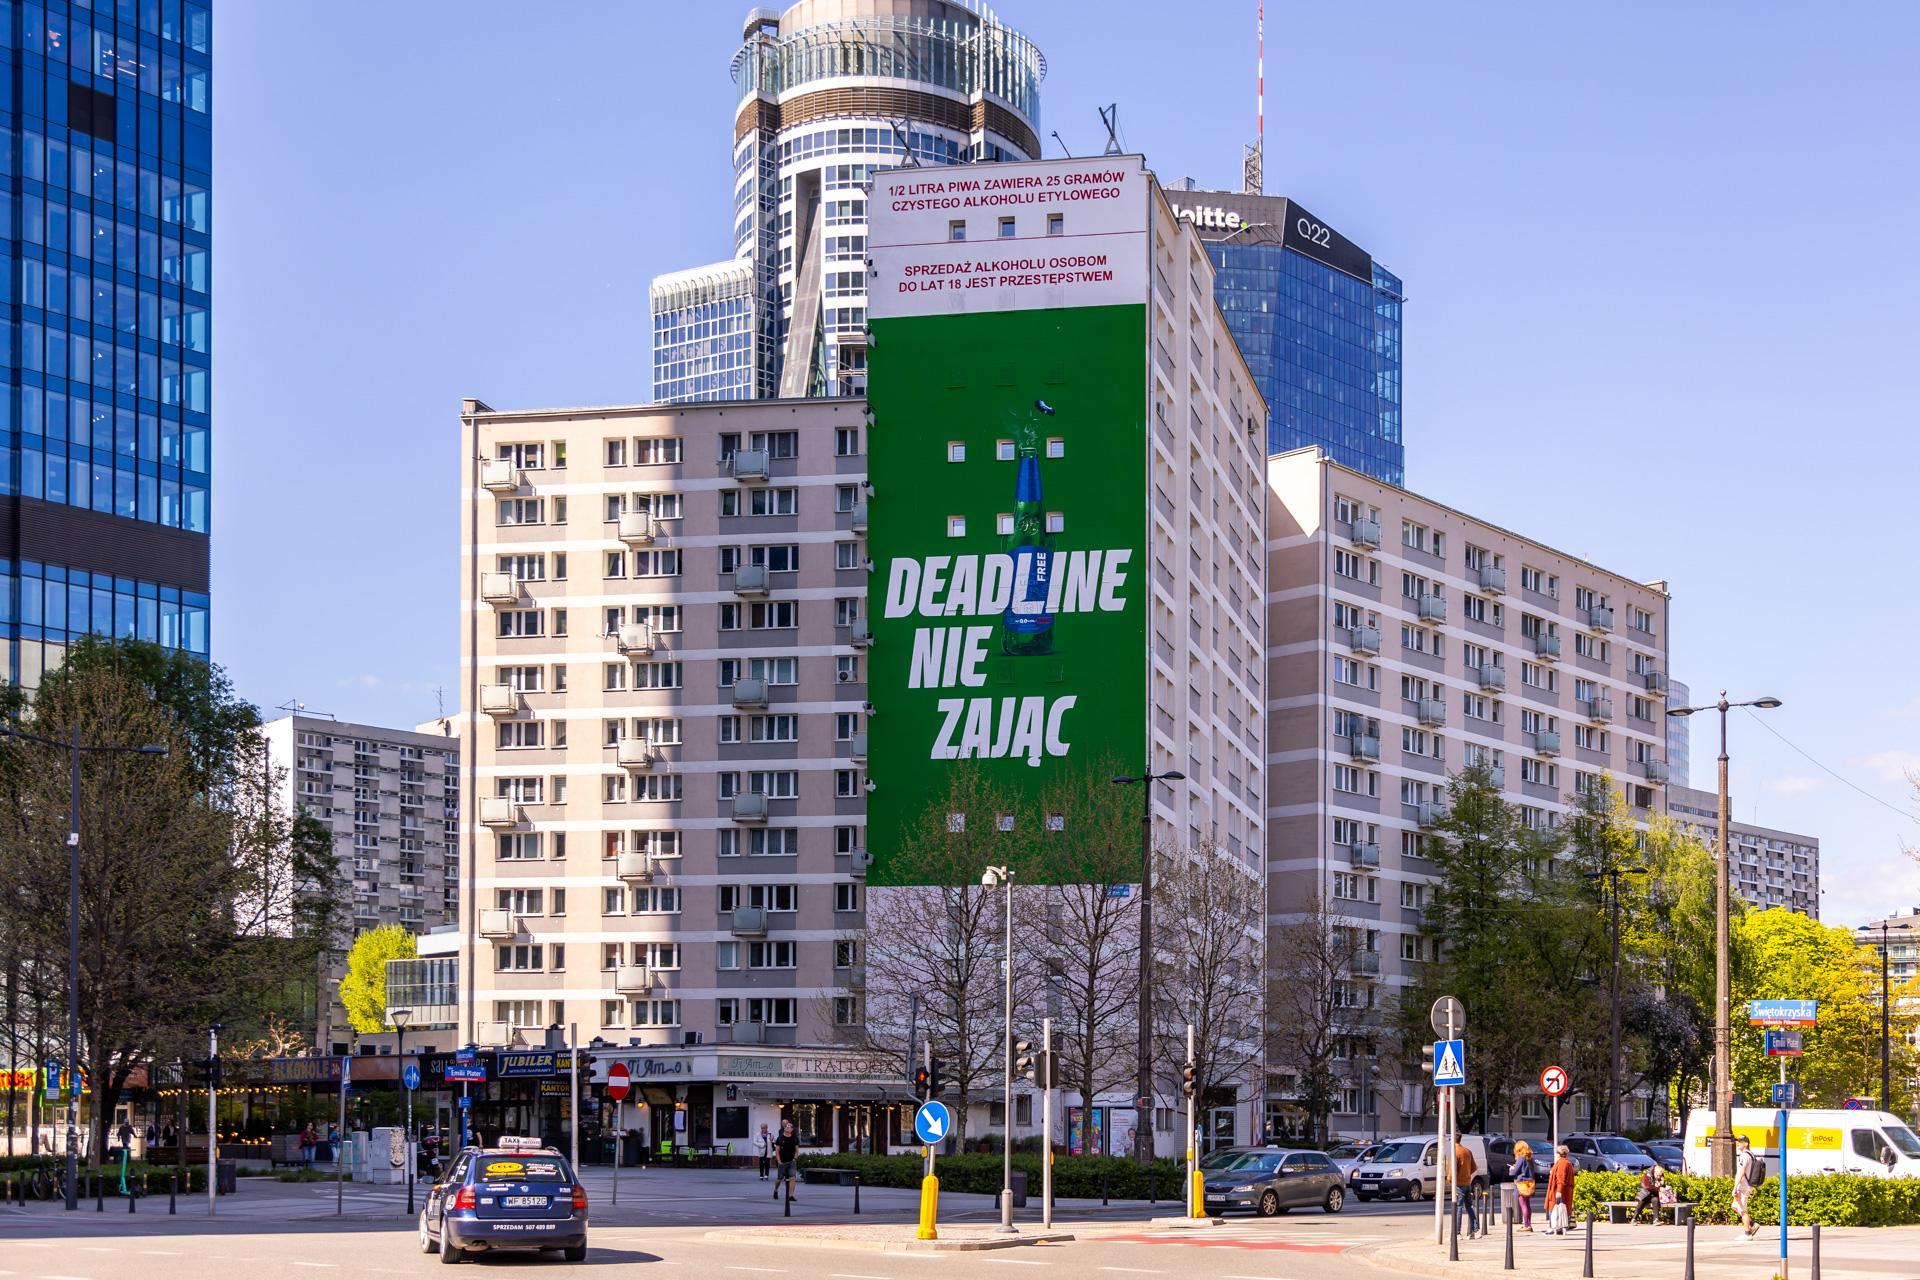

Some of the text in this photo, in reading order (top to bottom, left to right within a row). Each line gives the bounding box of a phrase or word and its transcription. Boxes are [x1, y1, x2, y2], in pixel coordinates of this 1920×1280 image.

[889, 170, 1125, 196] 1/2 LITRA PIWA ZAWIERA 25 GRAMÓW
[892, 187, 1120, 212] CZYSTEGO ALKOHOLU ETYLOWEGO
[1172, 204, 1248, 228] loitte.
[1297, 217, 1330, 249] Q22
[904, 255, 1107, 277] SPRZEDAŻ ALKOHOLU OSOBOM
[899, 270, 1113, 292] DO LAT 18 JEST PRZESTĘPSTWEM
[1036, 552, 1047, 581] FREE
[884, 548, 1133, 618] DEADLINE
[908, 626, 993, 689] NIE
[930, 695, 1077, 767] ZAJĄC
[1753, 1005, 1812, 1020] Świętokrzyska
[272, 1060, 329, 1080] ALKOHOLE
[466, 1069, 481, 1077] Plater
[500, 1055, 553, 1075] JUBILER
[541, 1084, 570, 1092] KANTOR
[507, 1197, 519, 1205] WF
